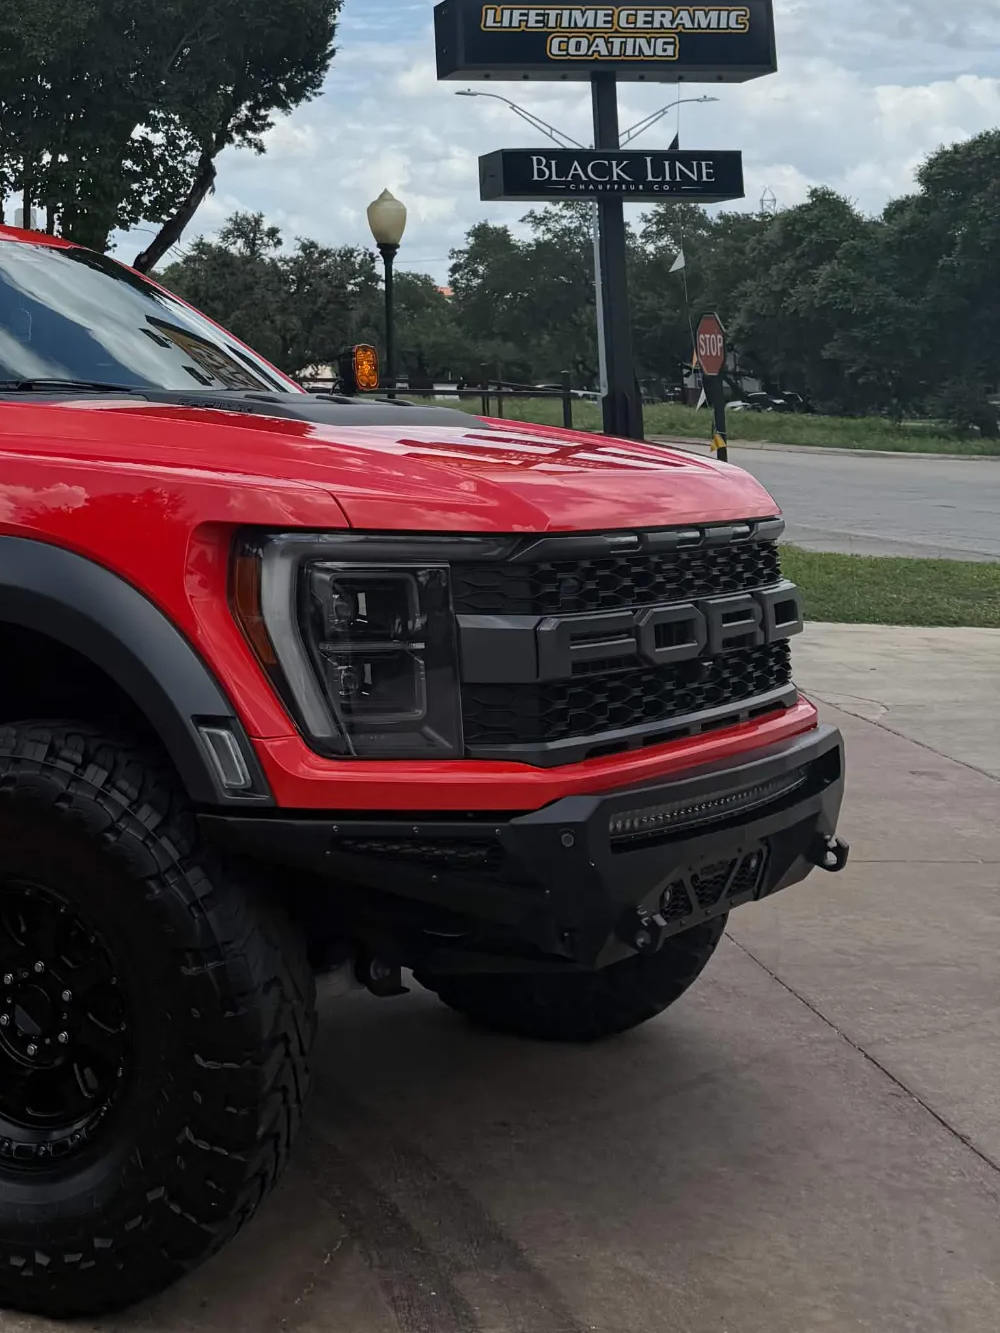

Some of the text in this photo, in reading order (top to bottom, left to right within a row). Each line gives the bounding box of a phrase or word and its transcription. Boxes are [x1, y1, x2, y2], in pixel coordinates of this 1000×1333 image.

[484, 9, 747, 29] LIFETIME CERAMIC
[550, 37, 675, 56] COATING
[530, 156, 715, 182] BLACK LINE
[569, 183, 677, 192] CHAUFFEUR CO.
[699, 334, 723, 356] STOP
[537, 582, 804, 683] FORD
